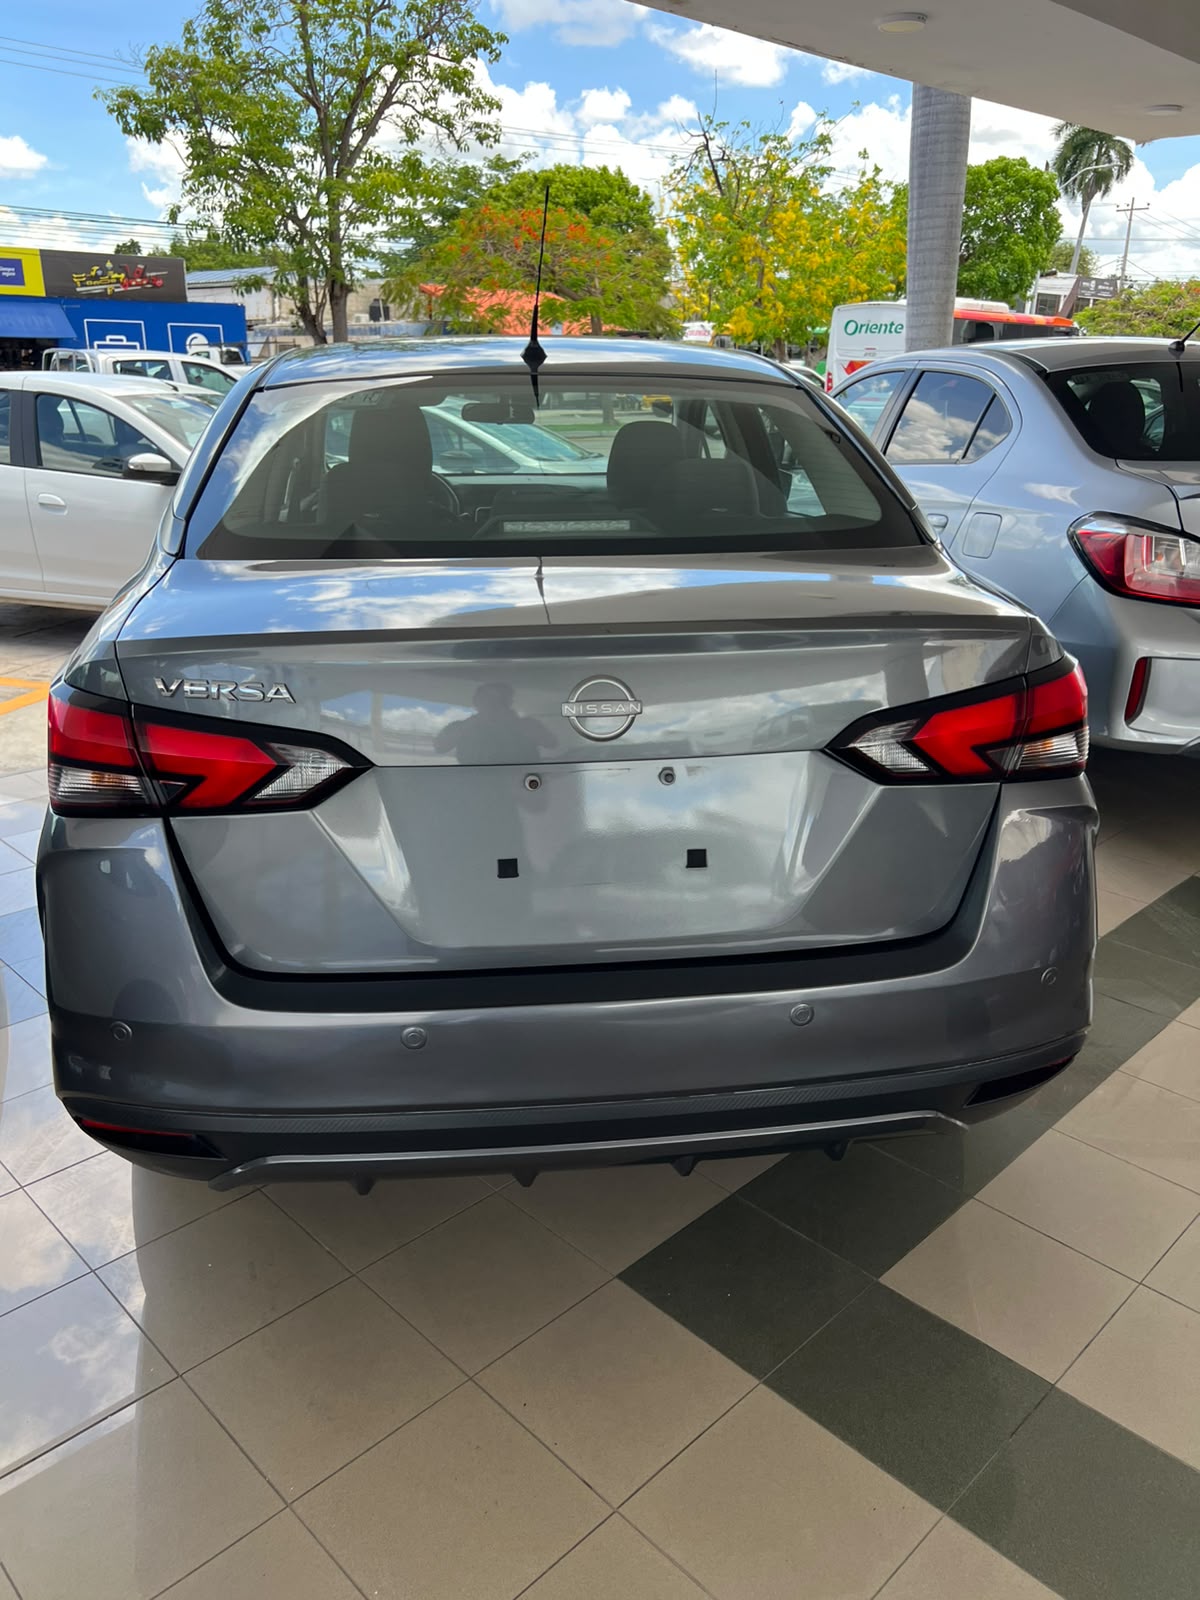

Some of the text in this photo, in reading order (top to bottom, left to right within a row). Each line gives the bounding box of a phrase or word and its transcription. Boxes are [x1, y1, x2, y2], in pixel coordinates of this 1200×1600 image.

[844, 319, 904, 336] Oriente
[153, 677, 297, 703] VERSA
[563, 703, 641, 714] NISSAN
